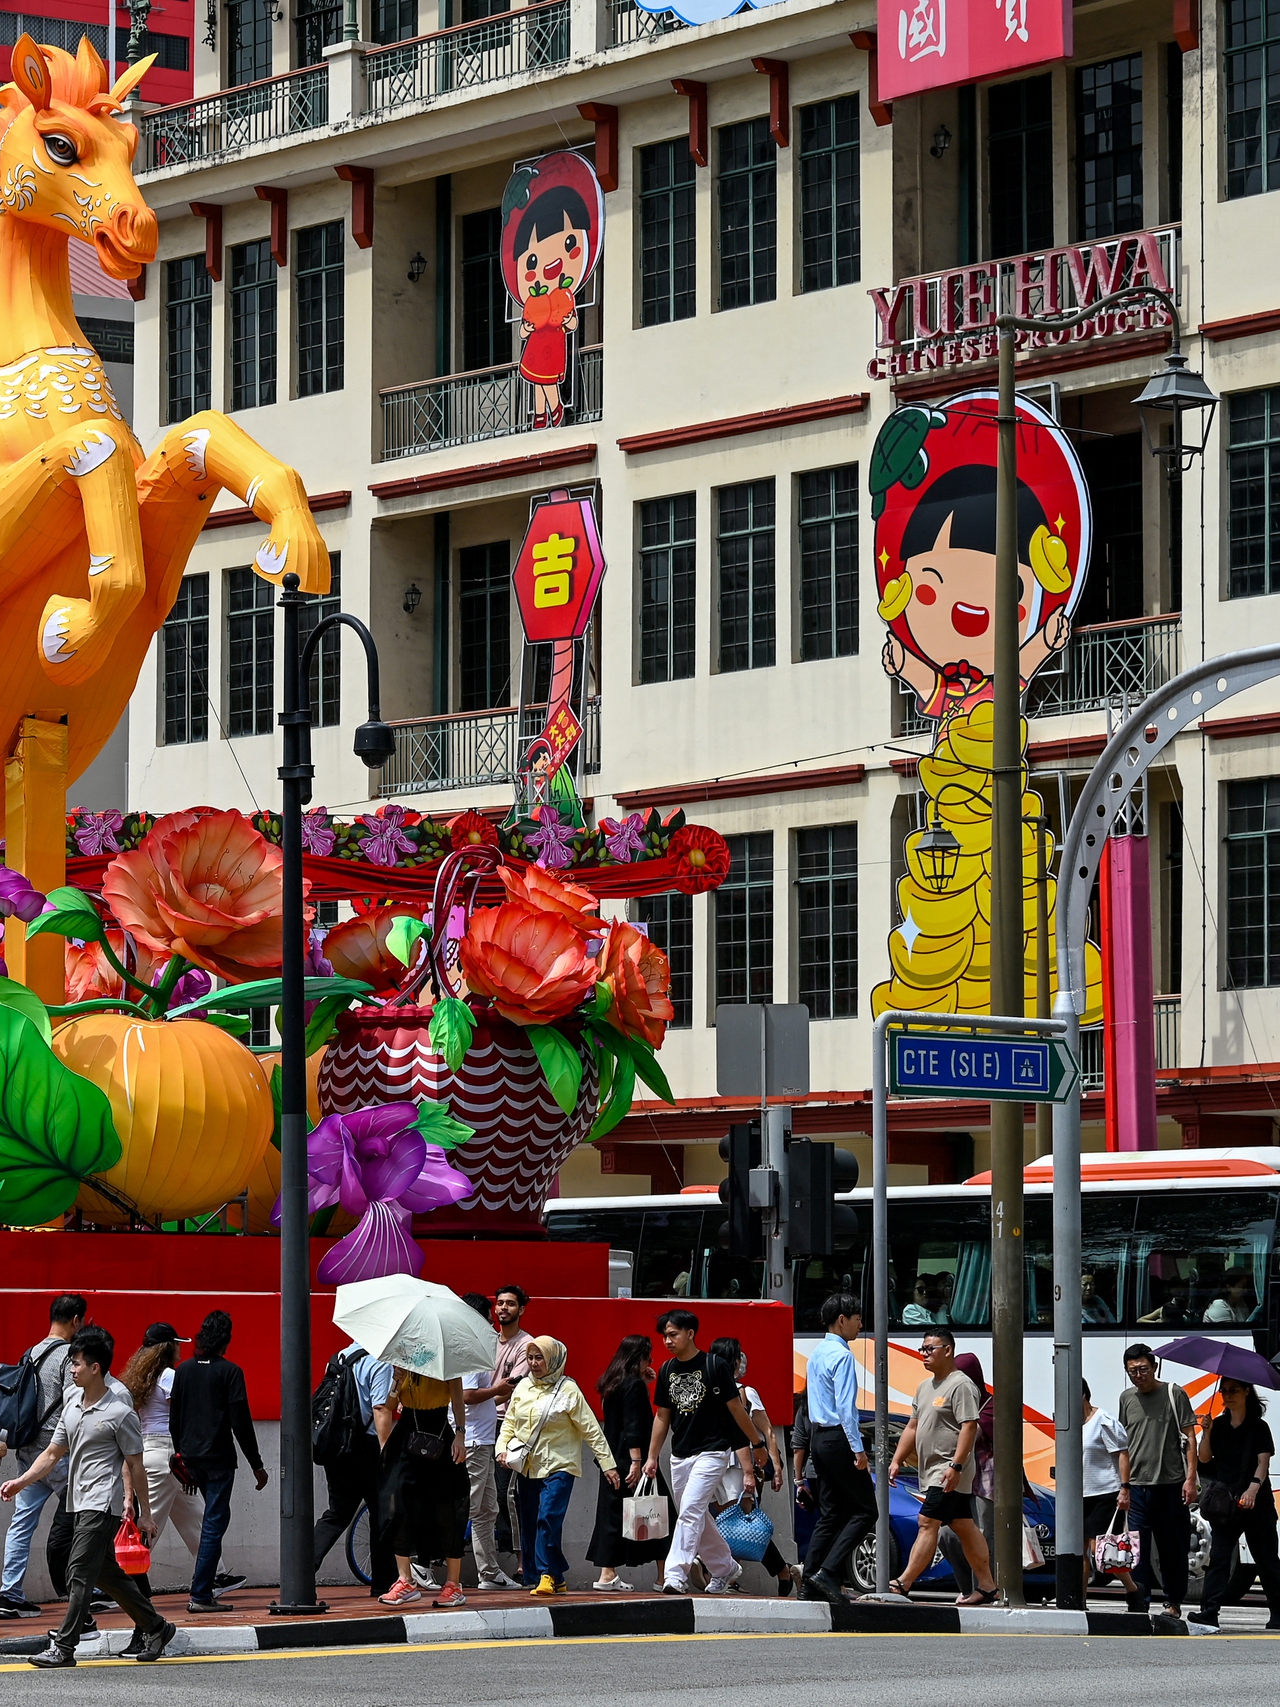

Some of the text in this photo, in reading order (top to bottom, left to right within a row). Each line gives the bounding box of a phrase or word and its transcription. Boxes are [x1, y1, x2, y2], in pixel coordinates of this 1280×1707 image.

[867, 232, 1174, 348] YUE HWA
[867, 303, 1172, 380] CHINESE PRODUCTS
[532, 533, 575, 609] 吉
[903, 1049, 939, 1076] CTE
